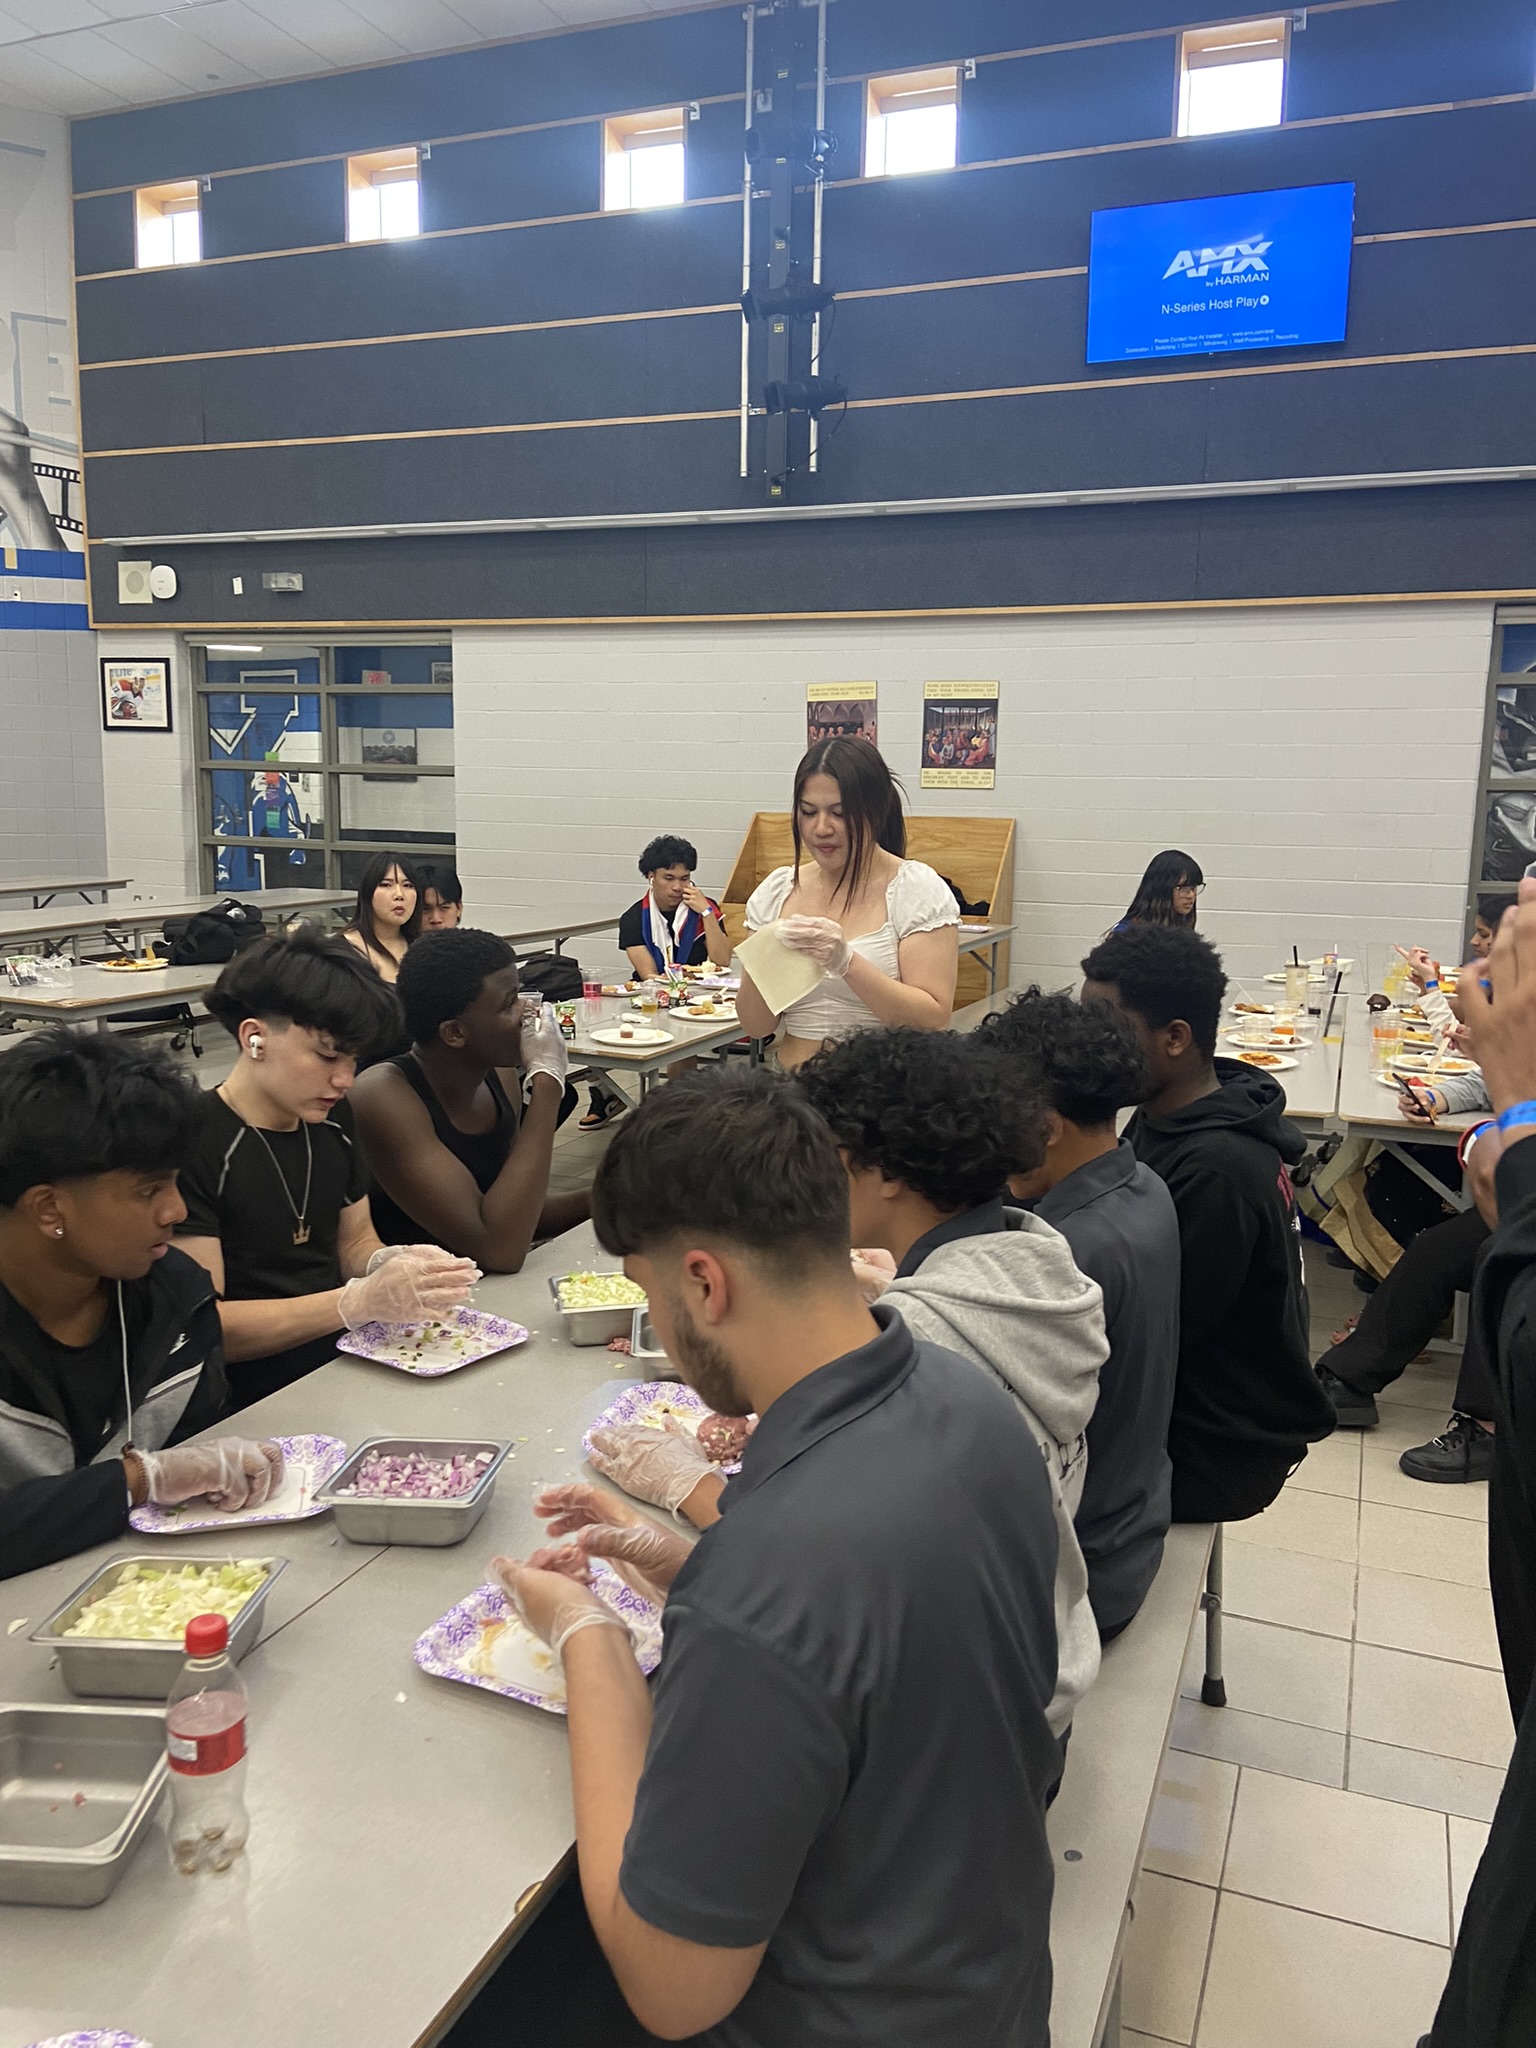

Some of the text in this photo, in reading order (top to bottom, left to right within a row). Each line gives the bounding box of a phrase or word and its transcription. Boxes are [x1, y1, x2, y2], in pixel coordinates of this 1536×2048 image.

[1162, 241, 1273, 280] AMX
[1215, 272, 1270, 286] HARMAN
[1161, 296, 1259, 314] N-Series Host Play
